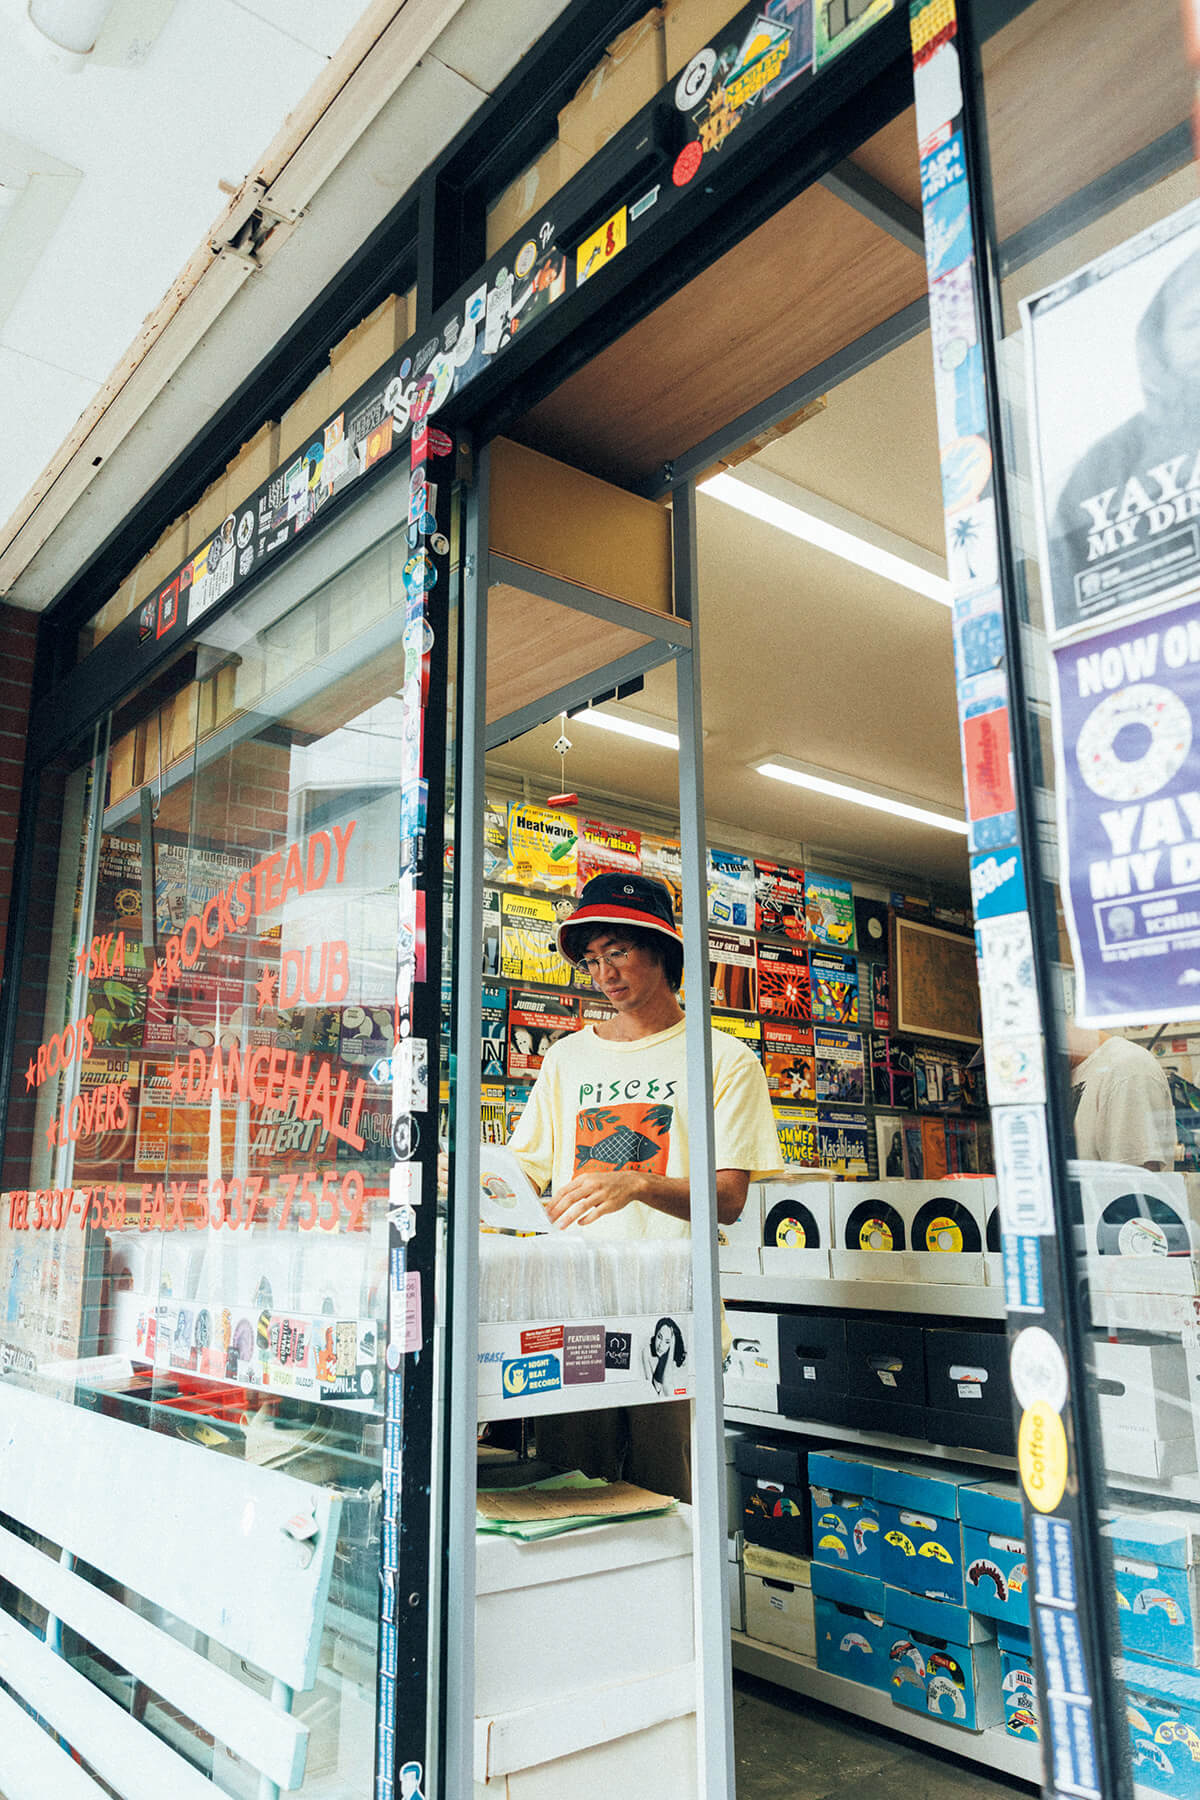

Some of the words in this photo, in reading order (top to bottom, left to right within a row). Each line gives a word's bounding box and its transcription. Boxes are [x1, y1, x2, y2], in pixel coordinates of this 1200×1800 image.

[1086, 515, 1141, 562] MY
[1077, 632, 1159, 698] NOW
[517, 815, 574, 838] Heatwave
[1089, 848, 1162, 900] MY
[165, 820, 357, 988] ROCKSTEADY
[506, 903, 539, 917] FAMINE
[88, 931, 126, 980] SKA
[279, 940, 350, 1010] DUB
[36, 1014, 94, 1087] ROOTS
[58, 1080, 130, 1147] LOVERS
[187, 1044, 366, 1152] DANCEHALL
[8, 1189, 30, 1230] TEL
[32, 1183, 127, 1231] 5337-7558
[139, 1180, 190, 1233] FAX
[194, 1169, 366, 1233] 5337-7559
[528, 1358, 549, 1369] NIGHT
[568, 1334, 601, 1343] FEATURING
[529, 1369, 546, 1379] BEAT
[529, 1377, 560, 1389] RECORDS
[1027, 1414, 1046, 1492] Coffee
